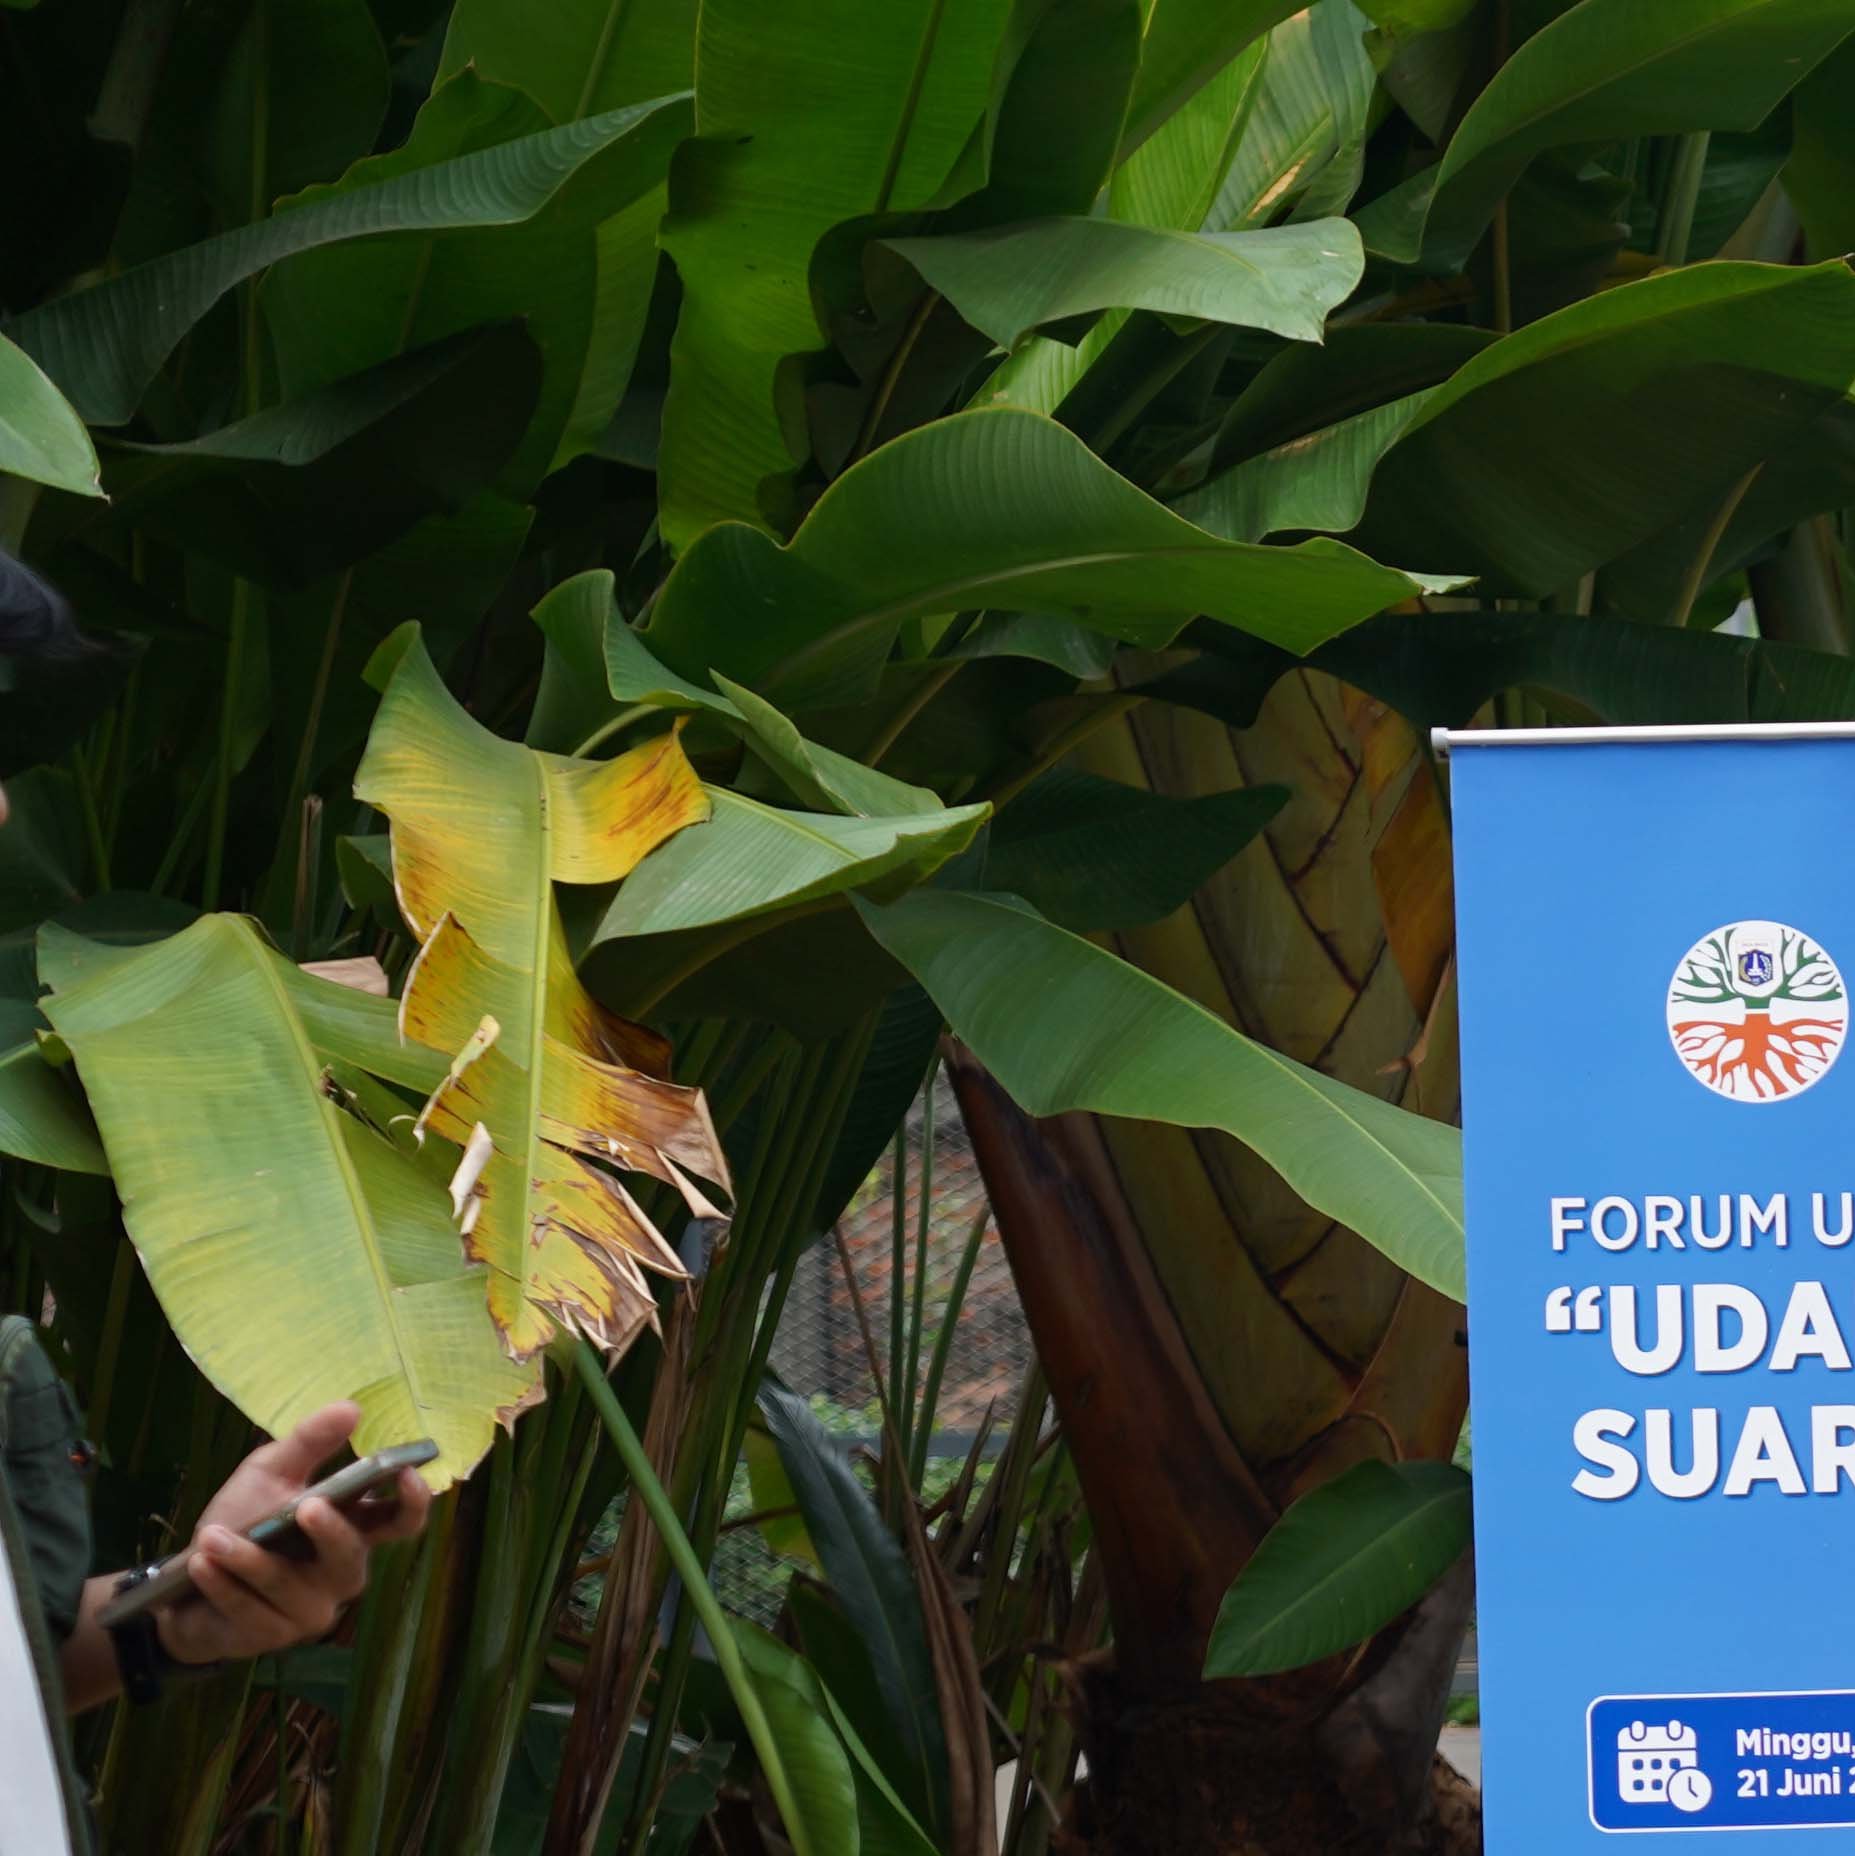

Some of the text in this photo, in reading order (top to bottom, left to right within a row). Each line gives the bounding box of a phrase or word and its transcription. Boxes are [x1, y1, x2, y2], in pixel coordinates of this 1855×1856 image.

[1550, 1193, 1787, 1251] FORUM
[1737, 1768, 1768, 1798] 21
[1776, 1766, 1841, 1797] Juni
